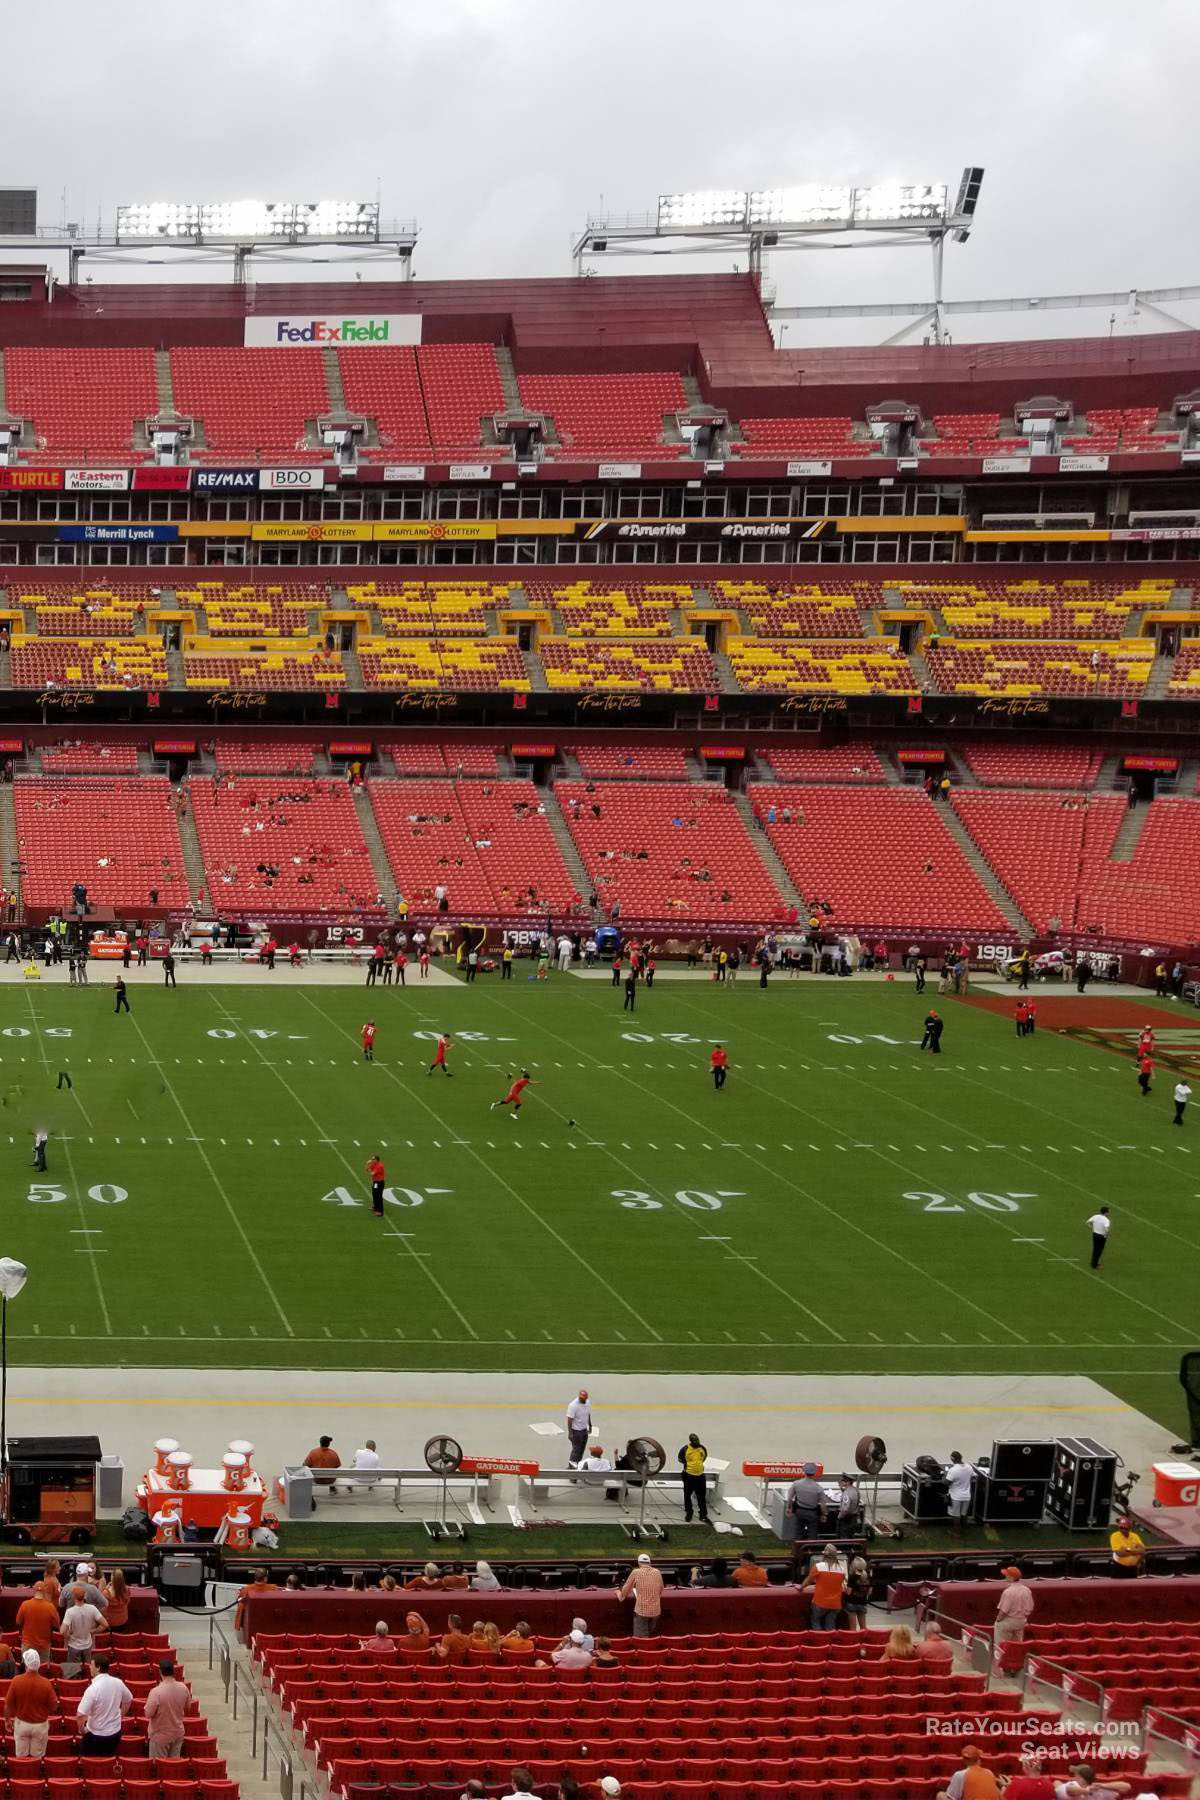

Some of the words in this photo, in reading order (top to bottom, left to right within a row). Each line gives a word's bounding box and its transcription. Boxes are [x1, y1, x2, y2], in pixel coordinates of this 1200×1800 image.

[277, 320, 389, 342] FedExField
[79, 471, 124, 481] Eastern
[197, 473, 255, 486] RE/MAX
[276, 471, 312, 484] BDO
[97, 529, 127, 539] Merrill
[128, 529, 154, 540] Lynch
[266, 529, 306, 537] MARYLAND
[323, 529, 357, 537] LOTTERY
[388, 528, 429, 536] MARYLAND
[447, 528, 480, 536] LOTTERY
[629, 524, 686, 537] Ameritel
[732, 524, 791, 537] Ameritel
[976, 944, 1014, 960] 1991
[27, 1183, 129, 1203] 50
[321, 1186, 424, 1207] 40
[610, 1189, 723, 1210] 30
[902, 1191, 1020, 1212] 20
[475, 1462, 521, 1472] GATORADE
[763, 1466, 806, 1475] GATORAD
[176, 1469, 187, 1481] G
[230, 1469, 241, 1481] G
[1180, 1486, 1199, 1503] G
[163, 1525, 174, 1538] G
[236, 1527, 246, 1540] G
